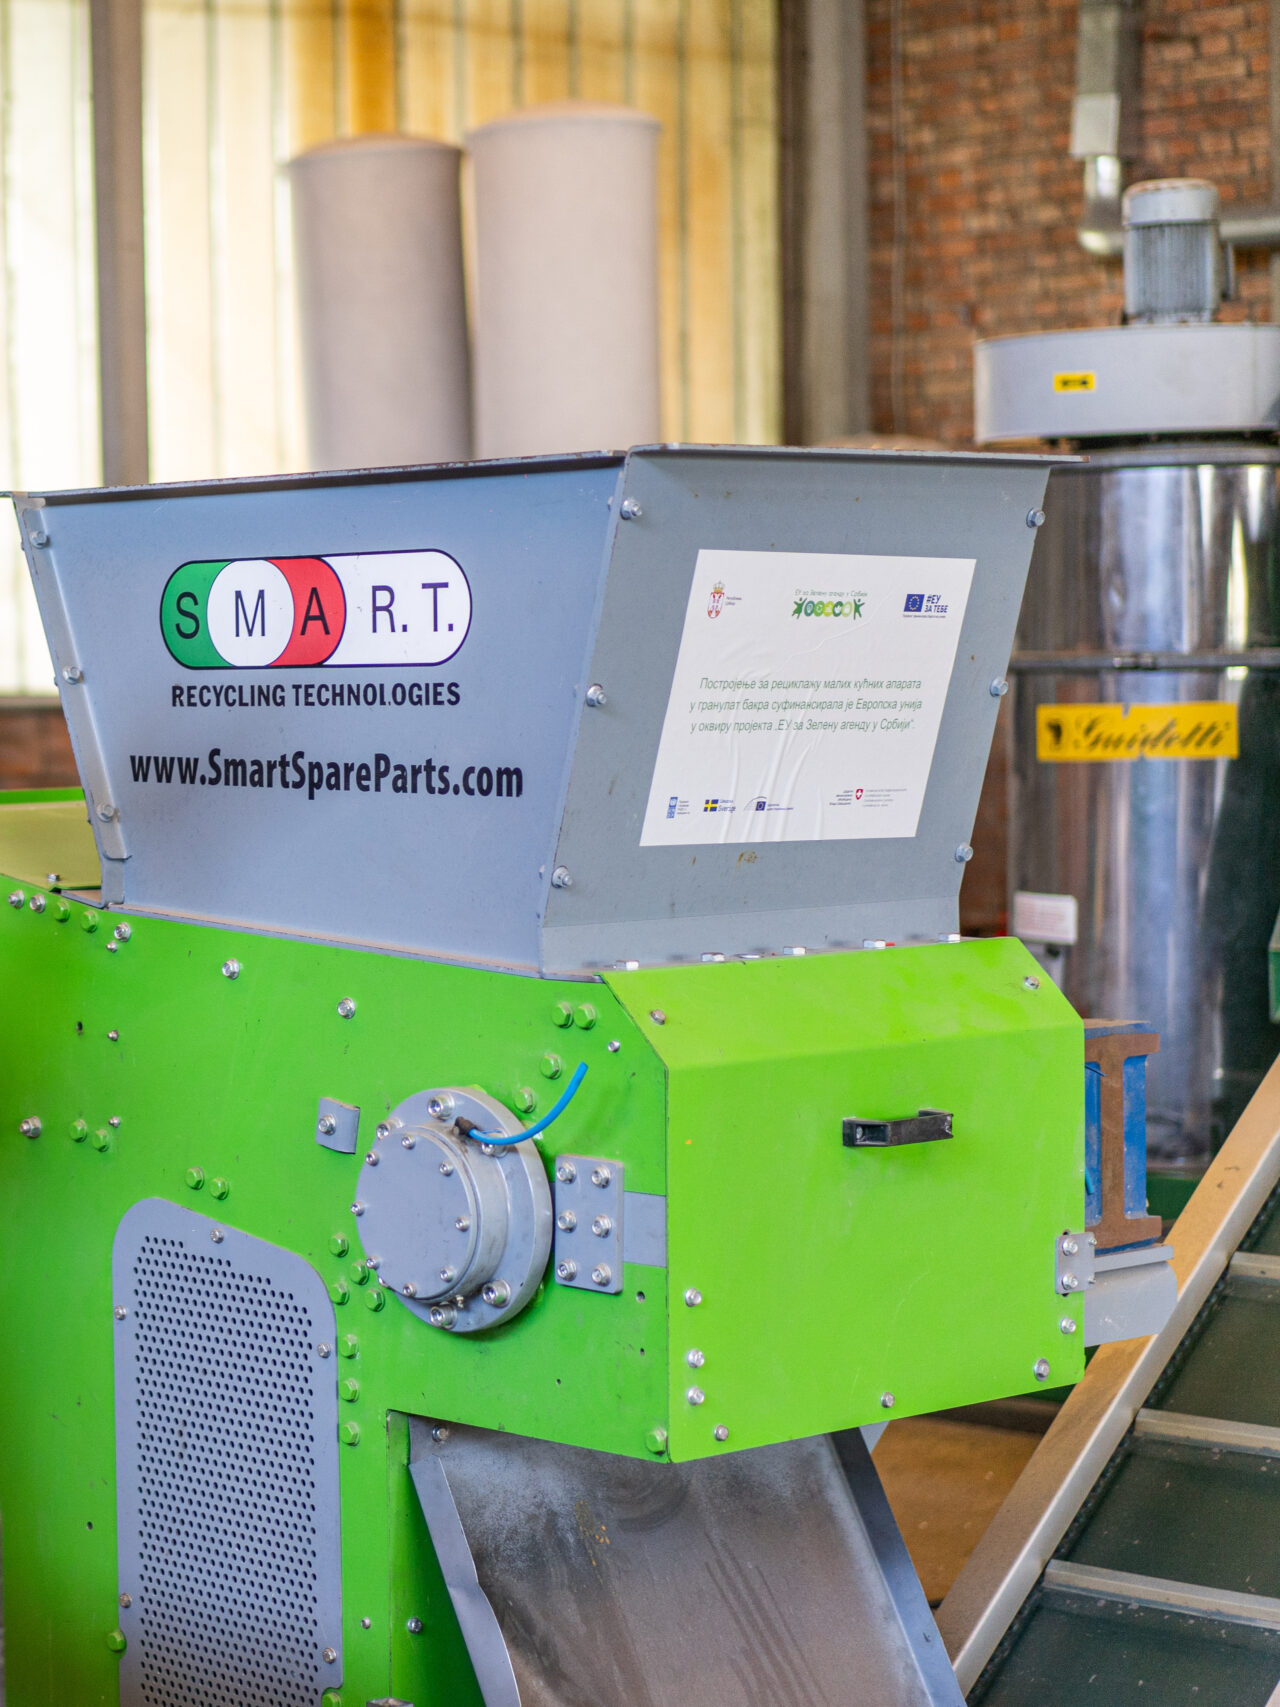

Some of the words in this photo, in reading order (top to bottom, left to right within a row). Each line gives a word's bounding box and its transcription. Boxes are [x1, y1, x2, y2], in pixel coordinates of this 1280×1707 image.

[700, 677, 756, 692] Постројење
[758, 680, 768, 689] за
[770, 679, 821, 692] рециклажу
[823, 679, 851, 689] малих
[853, 678, 884, 692] кућних
[885, 679, 922, 691] апарата
[171, 683, 286, 707] RECYCLING
[292, 681, 461, 706] TECHNOLOGIES
[689, 701, 696, 713] у
[698, 700, 740, 712] гранулат
[742, 698, 769, 712] бакра
[771, 699, 844, 713] суфинансирала
[844, 699, 854, 712] је
[855, 698, 898, 712] Европска
[898, 699, 923, 712] унија
[690, 722, 697, 735] у
[698, 722, 731, 734] оквиру
[733, 720, 773, 734] пројекта
[793, 721, 804, 731] за
[805, 718, 839, 733] Зелену
[840, 720, 871, 733] агенду
[871, 721, 878, 733] у
[129, 748, 524, 801] www.SmartSpareParts.com
